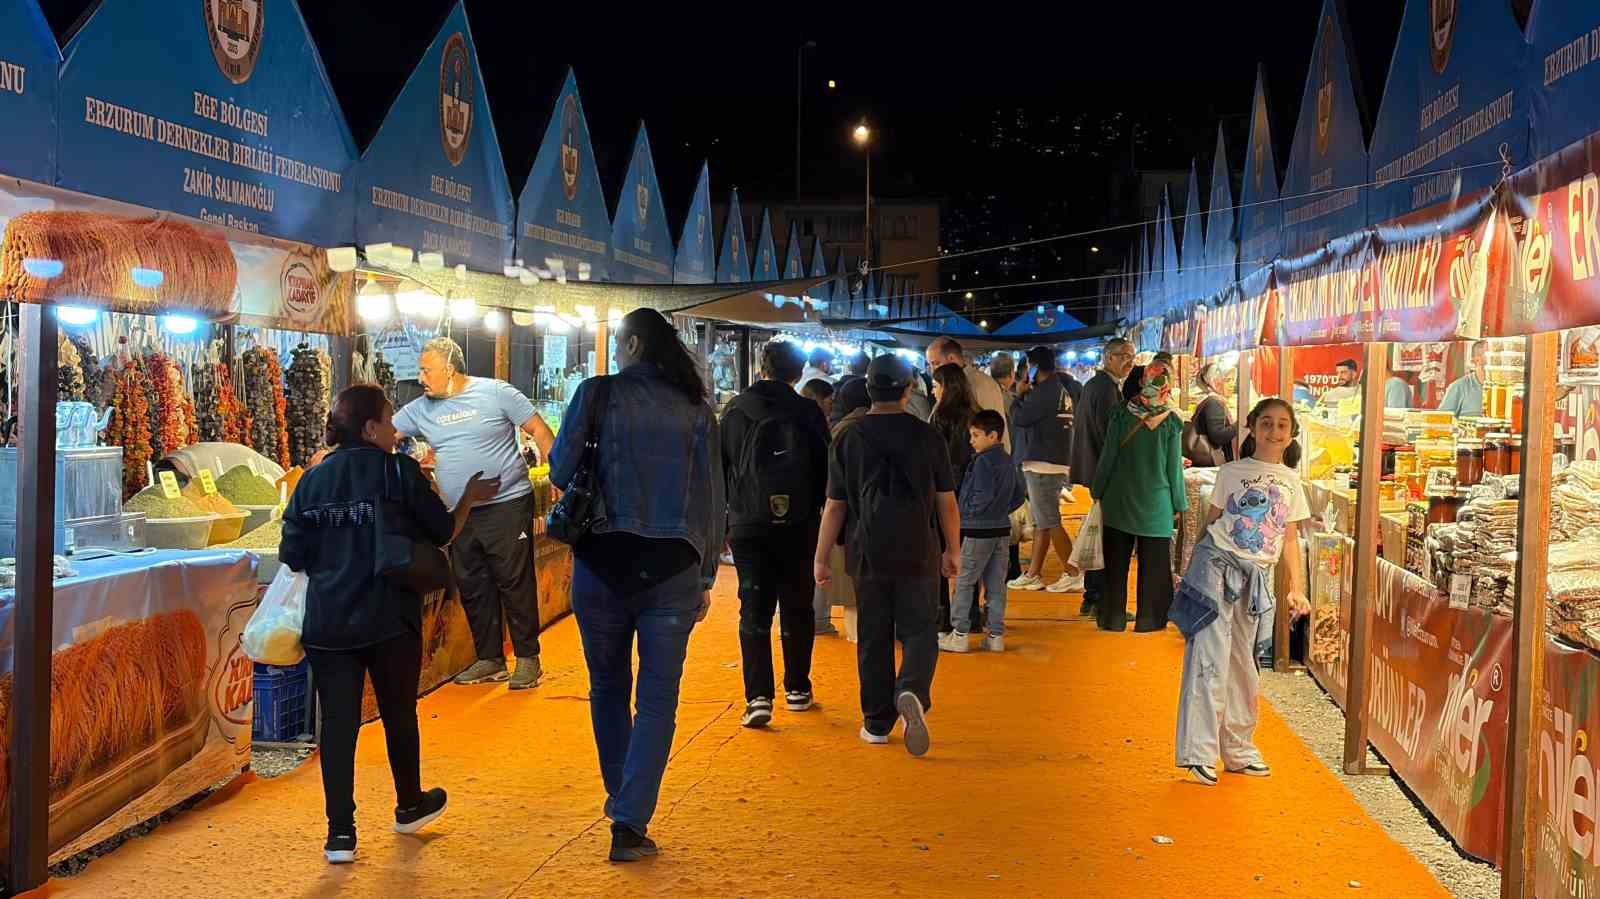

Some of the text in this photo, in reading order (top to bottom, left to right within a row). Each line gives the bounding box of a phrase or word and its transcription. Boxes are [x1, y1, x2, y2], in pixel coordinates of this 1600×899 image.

[1544, 33, 1589, 87] ERZURUM
[194, 91, 268, 137] EGE BÖLGESİ
[85, 96, 342, 193] ERZURUM DERNEKLER BİRLİĞİ FEDERASYONU
[183, 165, 274, 212] ZAKİR SALMANOĞLU
